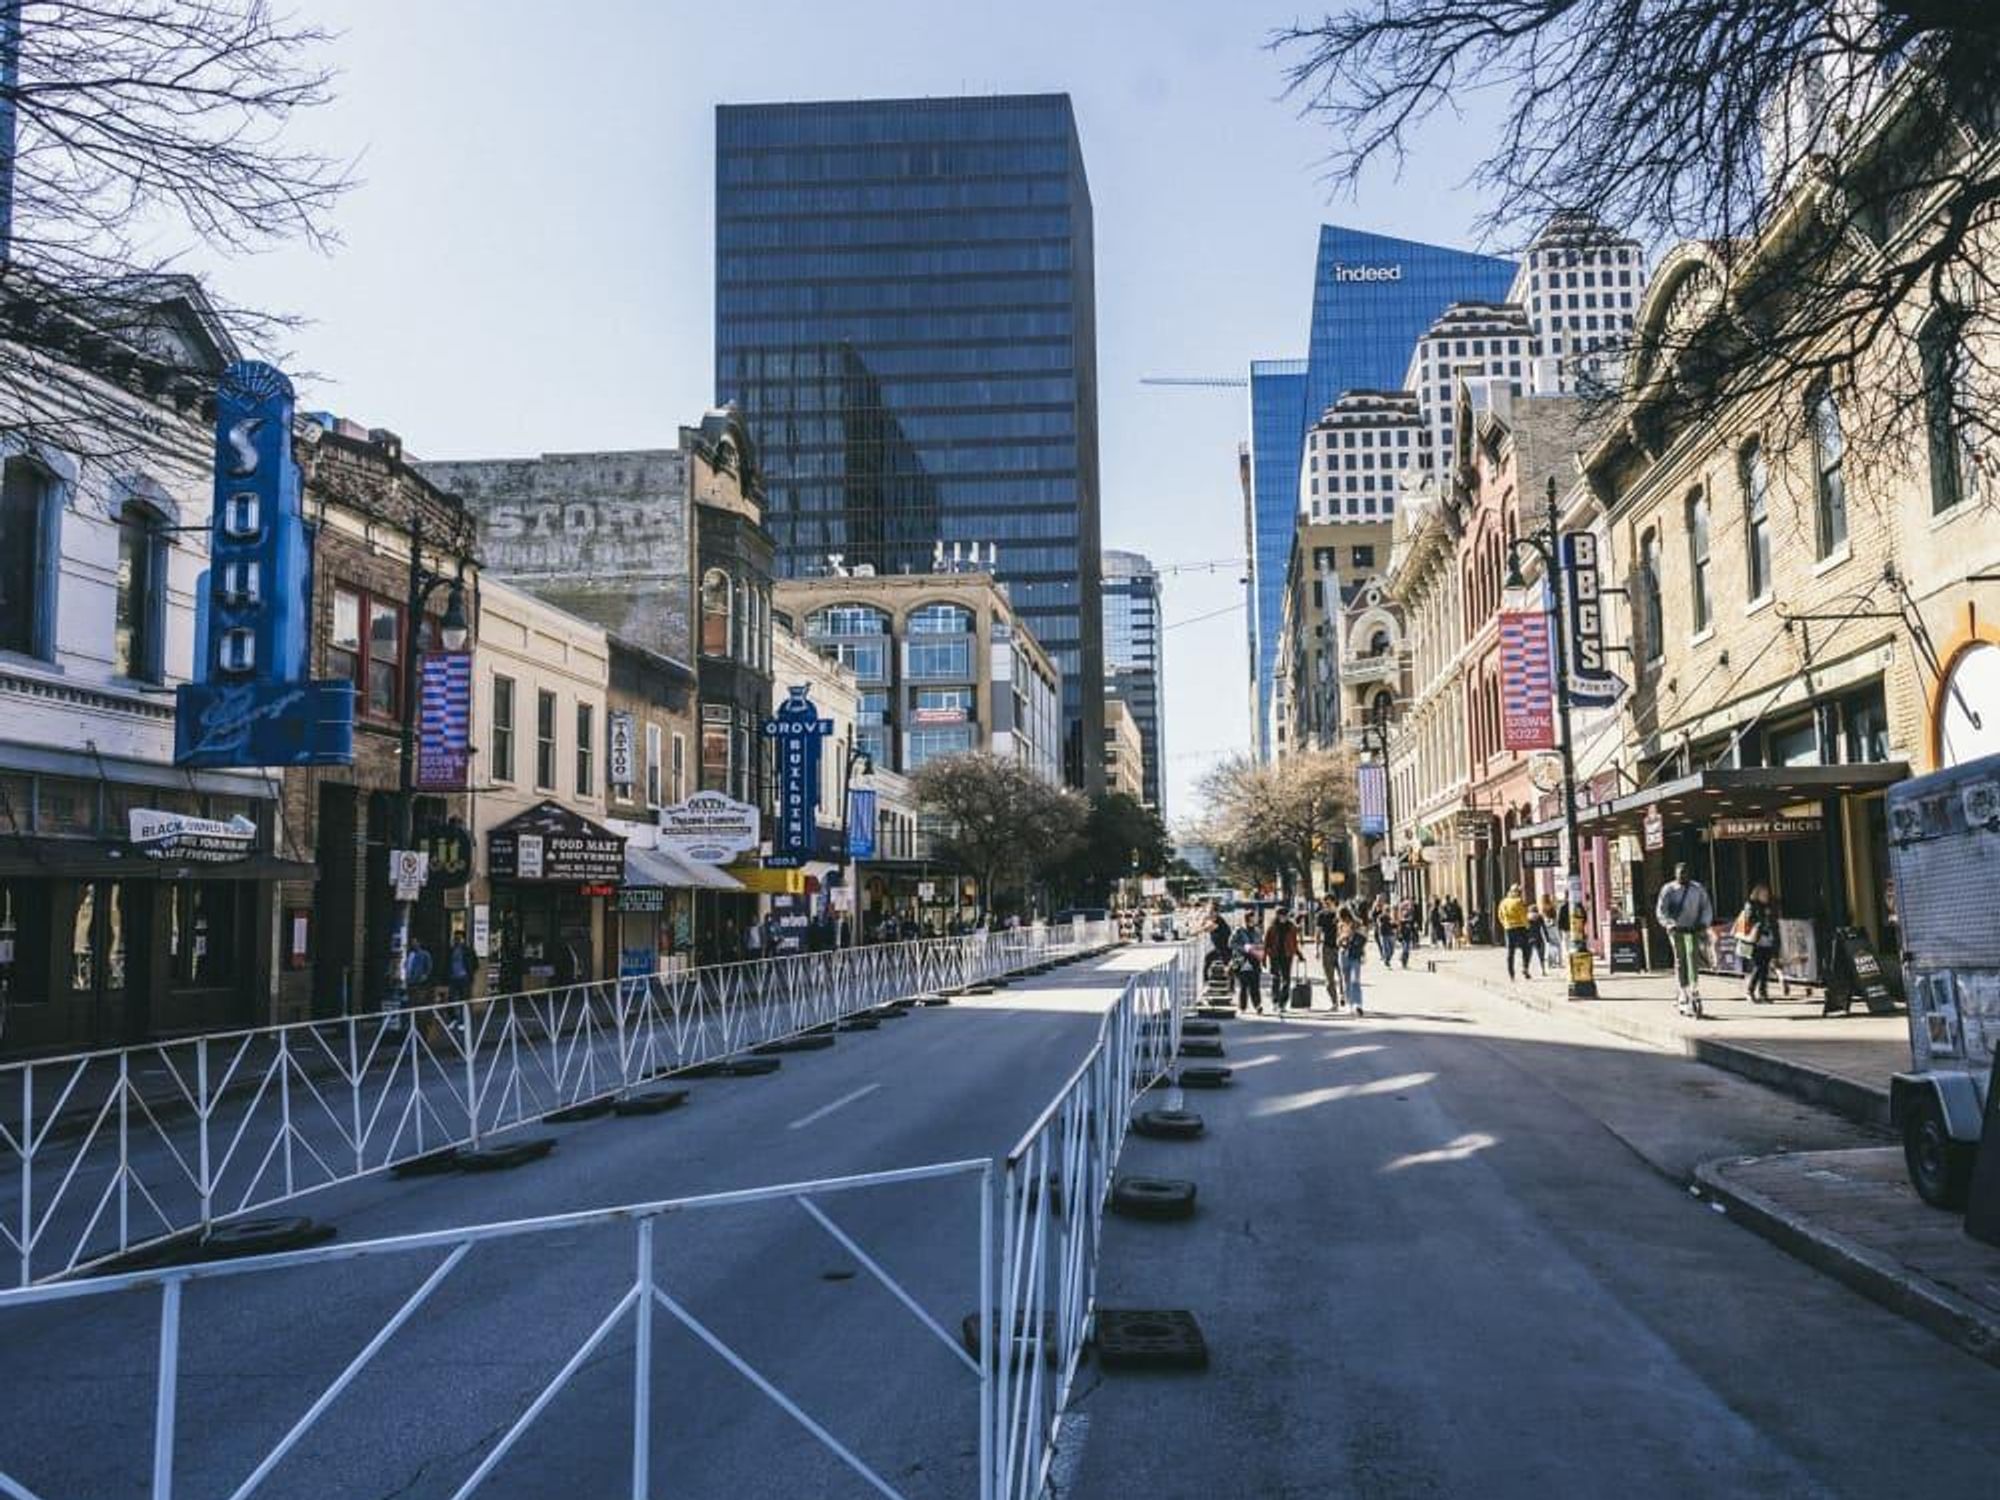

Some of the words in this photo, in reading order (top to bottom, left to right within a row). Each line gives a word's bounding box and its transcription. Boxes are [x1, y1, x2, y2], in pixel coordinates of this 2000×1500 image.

[1334, 263, 1402, 282] indeed
[1573, 534, 1602, 670] BBG'S
[1506, 727, 1540, 740] 2022
[789, 739, 802, 846] BUILDING
[142, 821, 184, 838] BLACK
[1727, 822, 1771, 834] HAPPY
[551, 838, 584, 850] FOOD
[586, 840, 619, 852] MART
